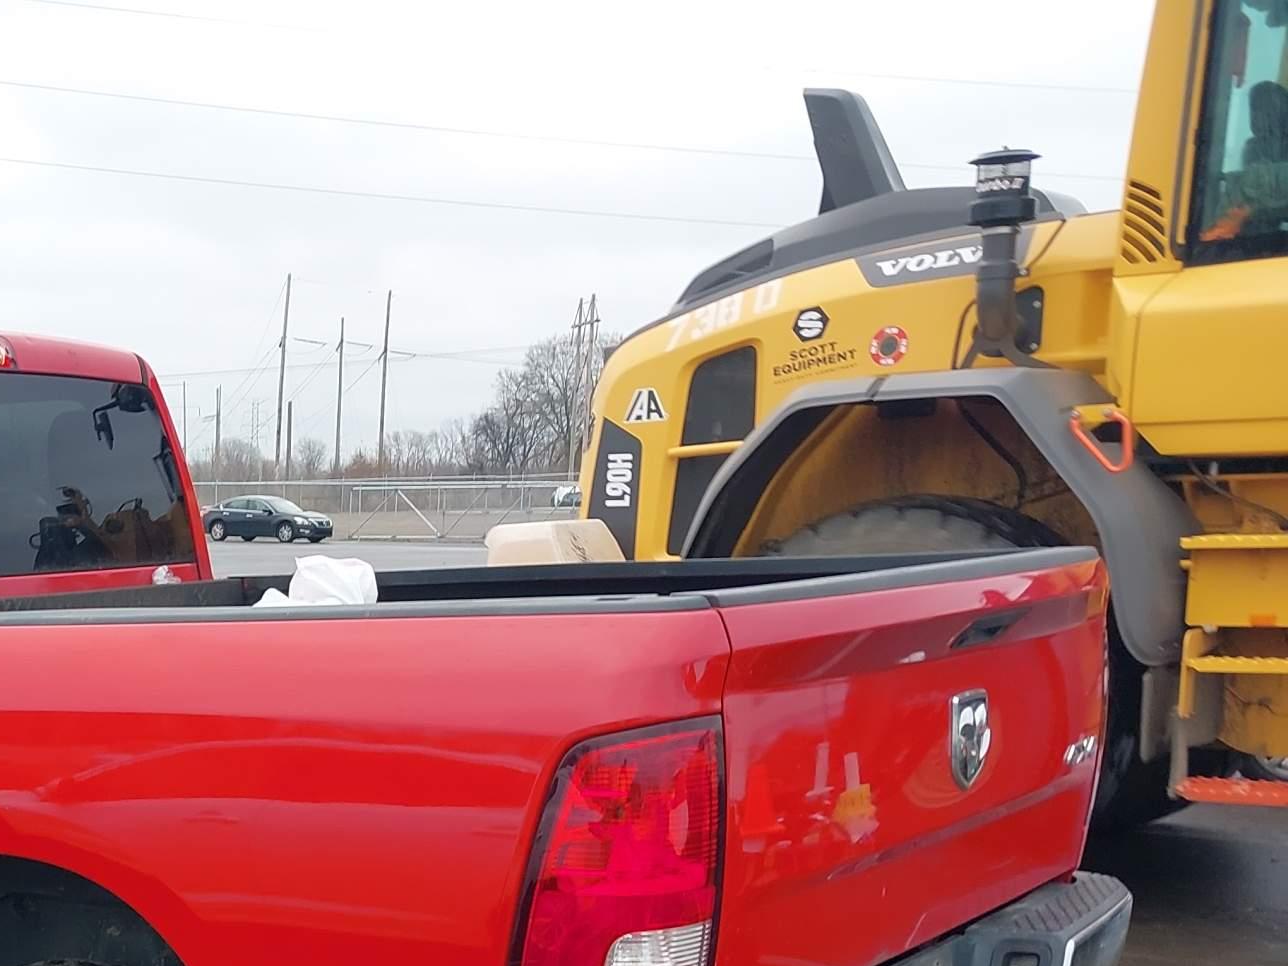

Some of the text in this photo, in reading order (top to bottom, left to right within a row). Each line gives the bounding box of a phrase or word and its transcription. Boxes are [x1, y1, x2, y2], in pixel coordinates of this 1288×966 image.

[876, 245, 983, 276] VOLV
[772, 348, 857, 377] EQUIPMENT
[789, 340, 839, 361] SCOTT
[604, 453, 633, 507] L90H
